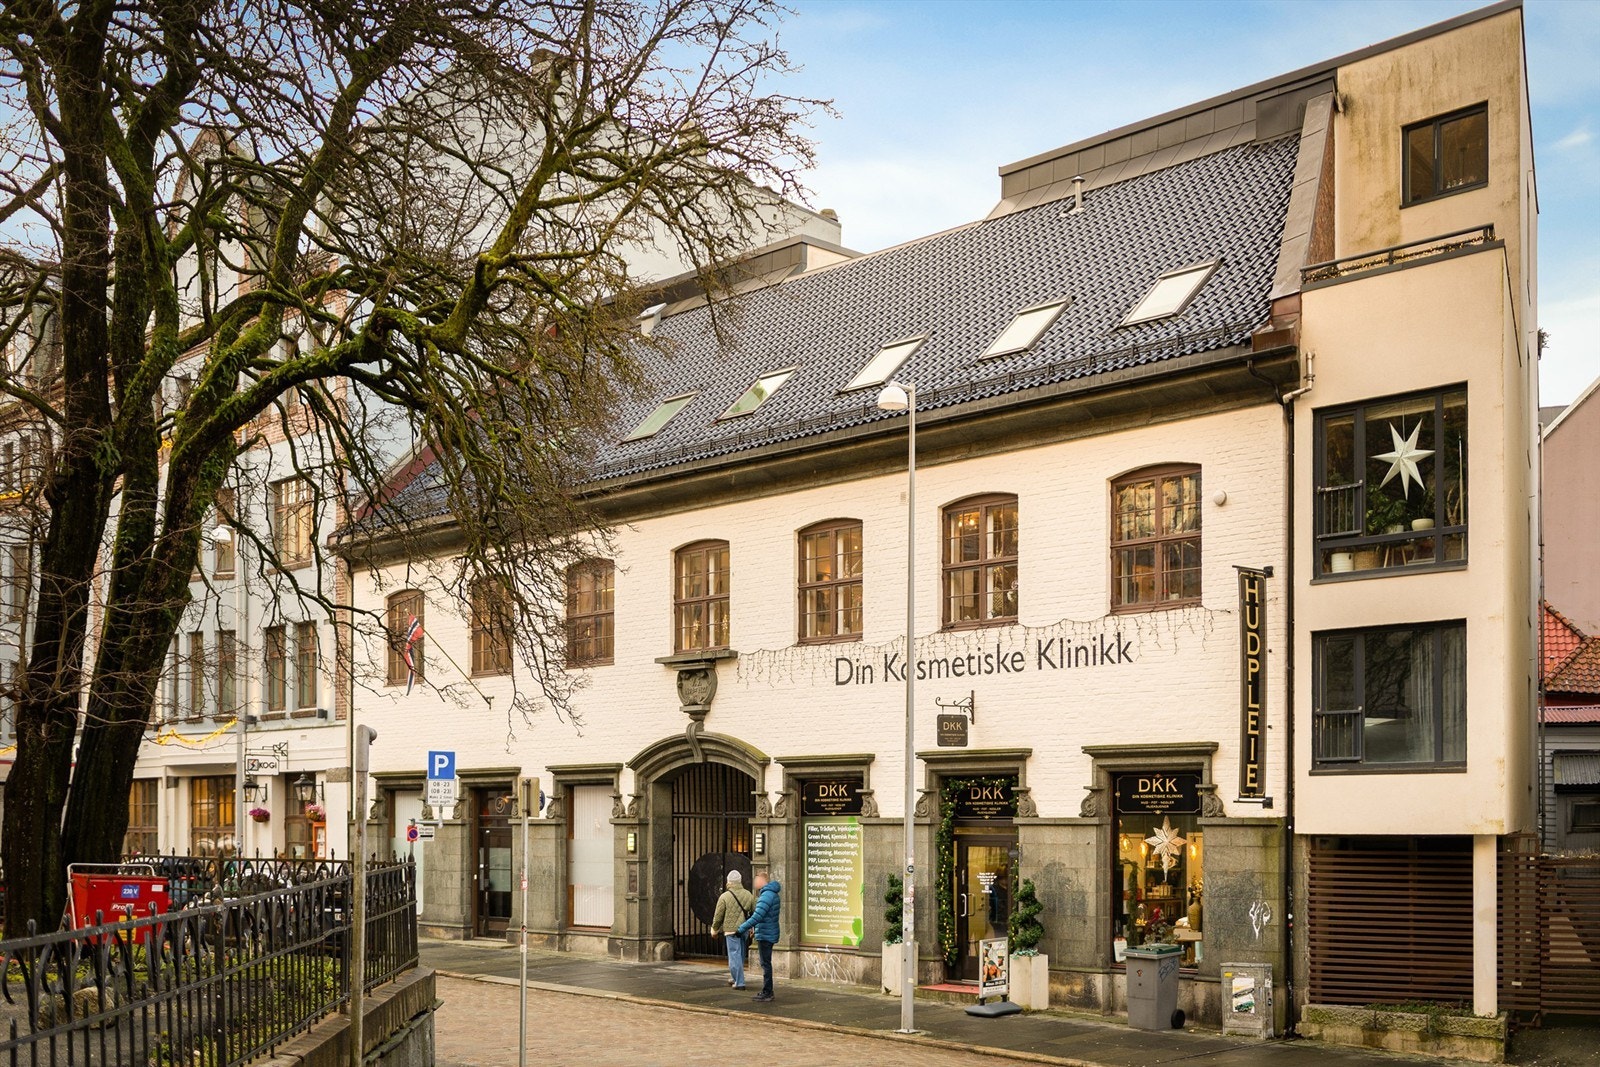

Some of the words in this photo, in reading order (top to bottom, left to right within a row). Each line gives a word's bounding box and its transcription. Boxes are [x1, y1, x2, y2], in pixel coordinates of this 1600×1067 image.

[835, 657, 874, 686] Din
[1037, 631, 1133, 670] Klinikk
[1244, 578, 1261, 788] HUDPLEIE
[943, 721, 962, 731] DKK
[434, 754, 450, 777] P
[819, 784, 848, 797] DKK
[1138, 778, 1178, 792] DKK
[970, 786, 1004, 800] DKK
